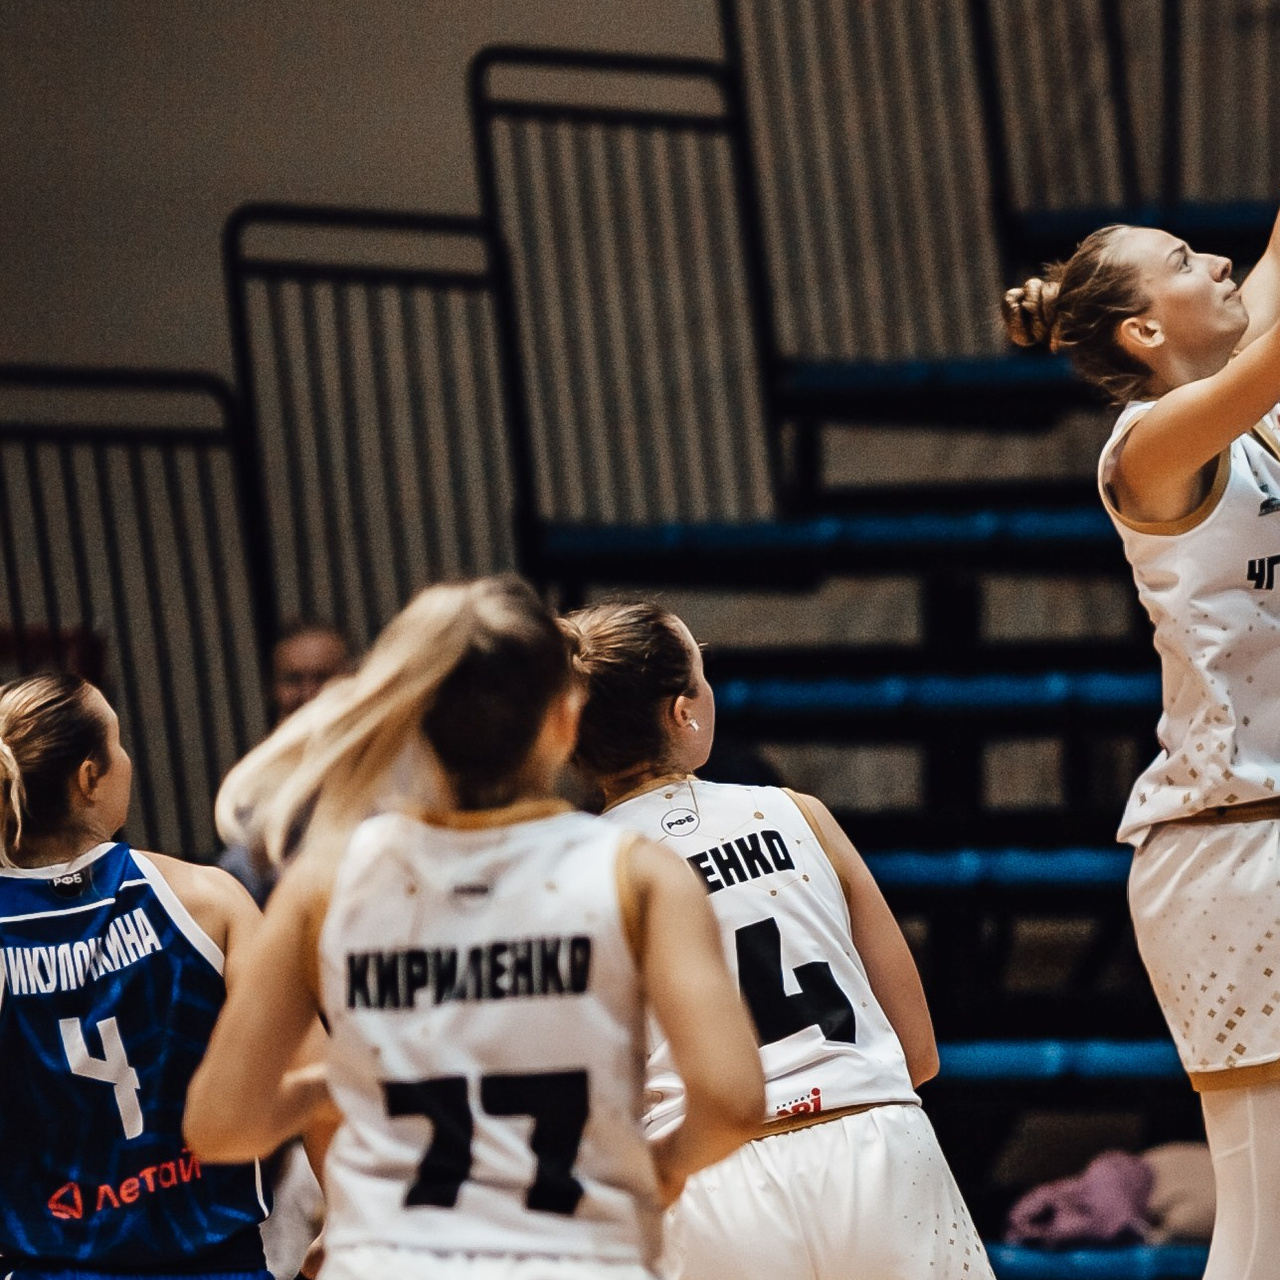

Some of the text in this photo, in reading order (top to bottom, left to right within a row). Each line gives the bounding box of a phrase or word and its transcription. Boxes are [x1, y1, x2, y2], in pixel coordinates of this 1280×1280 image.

[666, 814, 695, 829] РФБ
[53, 872, 82, 887] РФБ
[347, 935, 592, 1010] КИРИЛЕНКО
[58, 1016, 142, 1141] 4
[382, 1068, 589, 1216] 77
